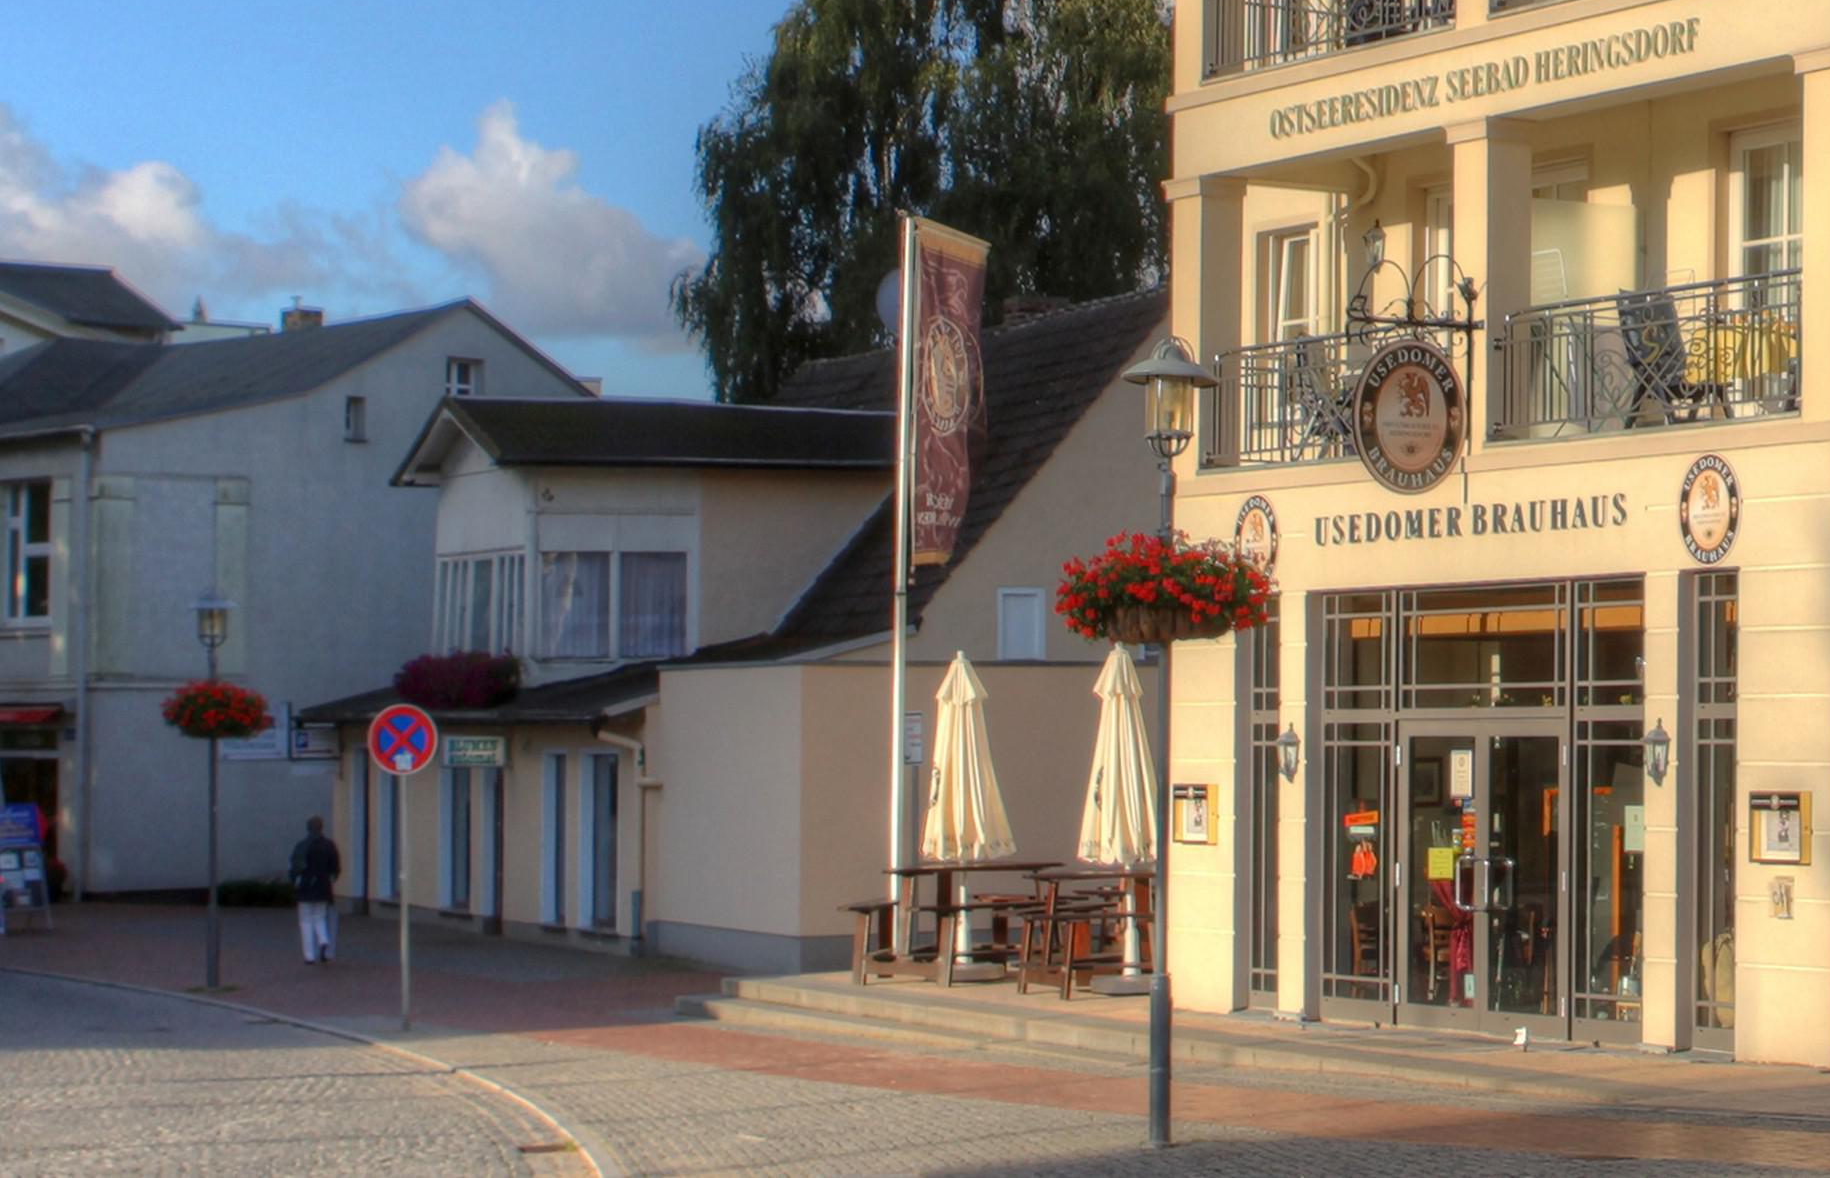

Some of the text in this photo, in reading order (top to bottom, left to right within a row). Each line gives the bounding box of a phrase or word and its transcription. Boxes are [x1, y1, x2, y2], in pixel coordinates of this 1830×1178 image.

[1269, 17, 1700, 140] OSTSEERESIDENZ SEEBAD HERINGSDORF
[1367, 348, 1454, 393] USEDOMER
[1367, 445, 1454, 488] BRAUHAUS
[1314, 492, 1628, 547] USEDOMER BRAUHAUS
